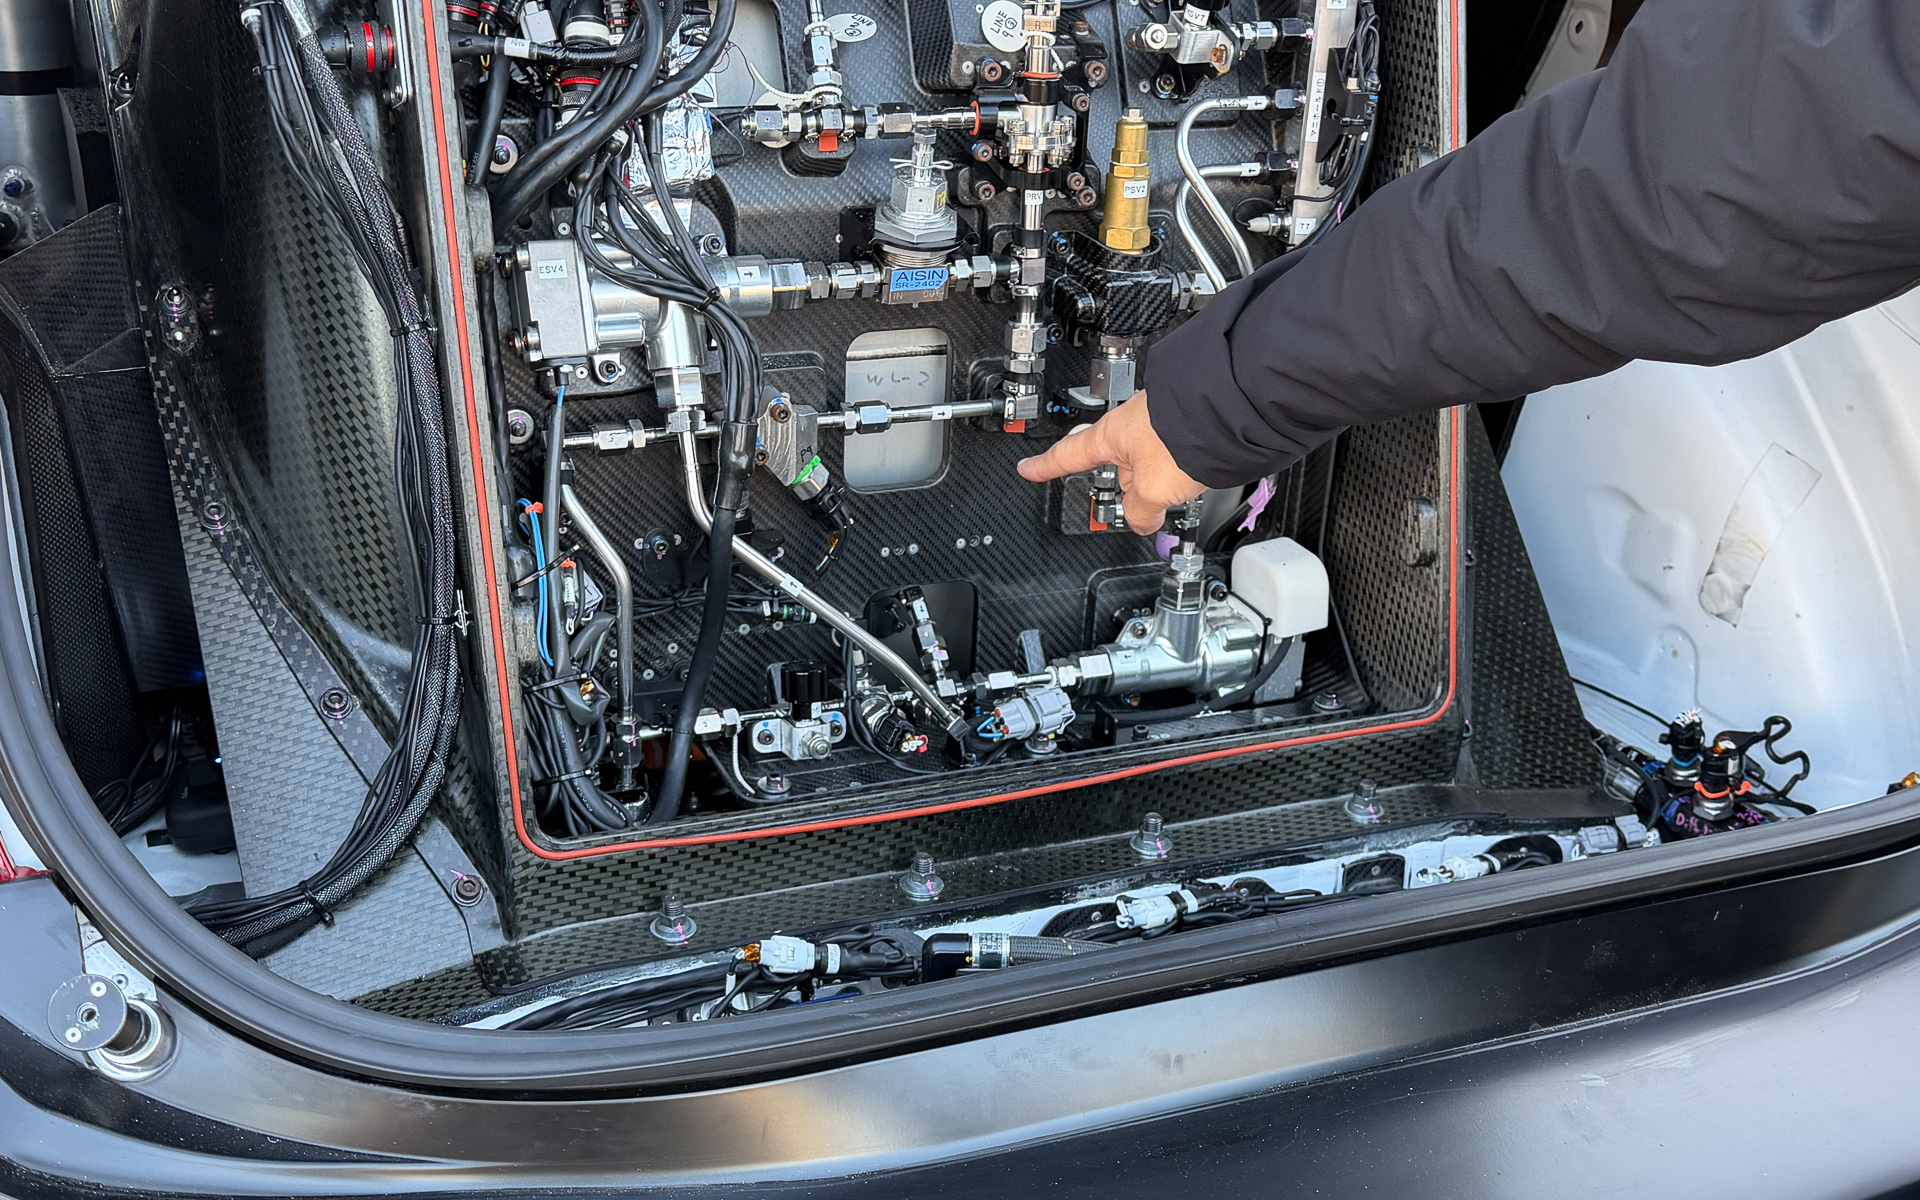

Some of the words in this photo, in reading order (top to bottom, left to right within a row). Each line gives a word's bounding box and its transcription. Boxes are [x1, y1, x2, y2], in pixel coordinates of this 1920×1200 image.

[851, 13, 874, 27] LINE
[990, 10, 1007, 34] LINE
[1124, 185, 1146, 194] PSV2
[1026, 192, 1042, 201] PRV
[1300, 222, 1310, 230] T7
[539, 264, 564, 274] ESV4
[896, 269, 944, 282] AISIN
[895, 280, 943, 289] SR-2402
